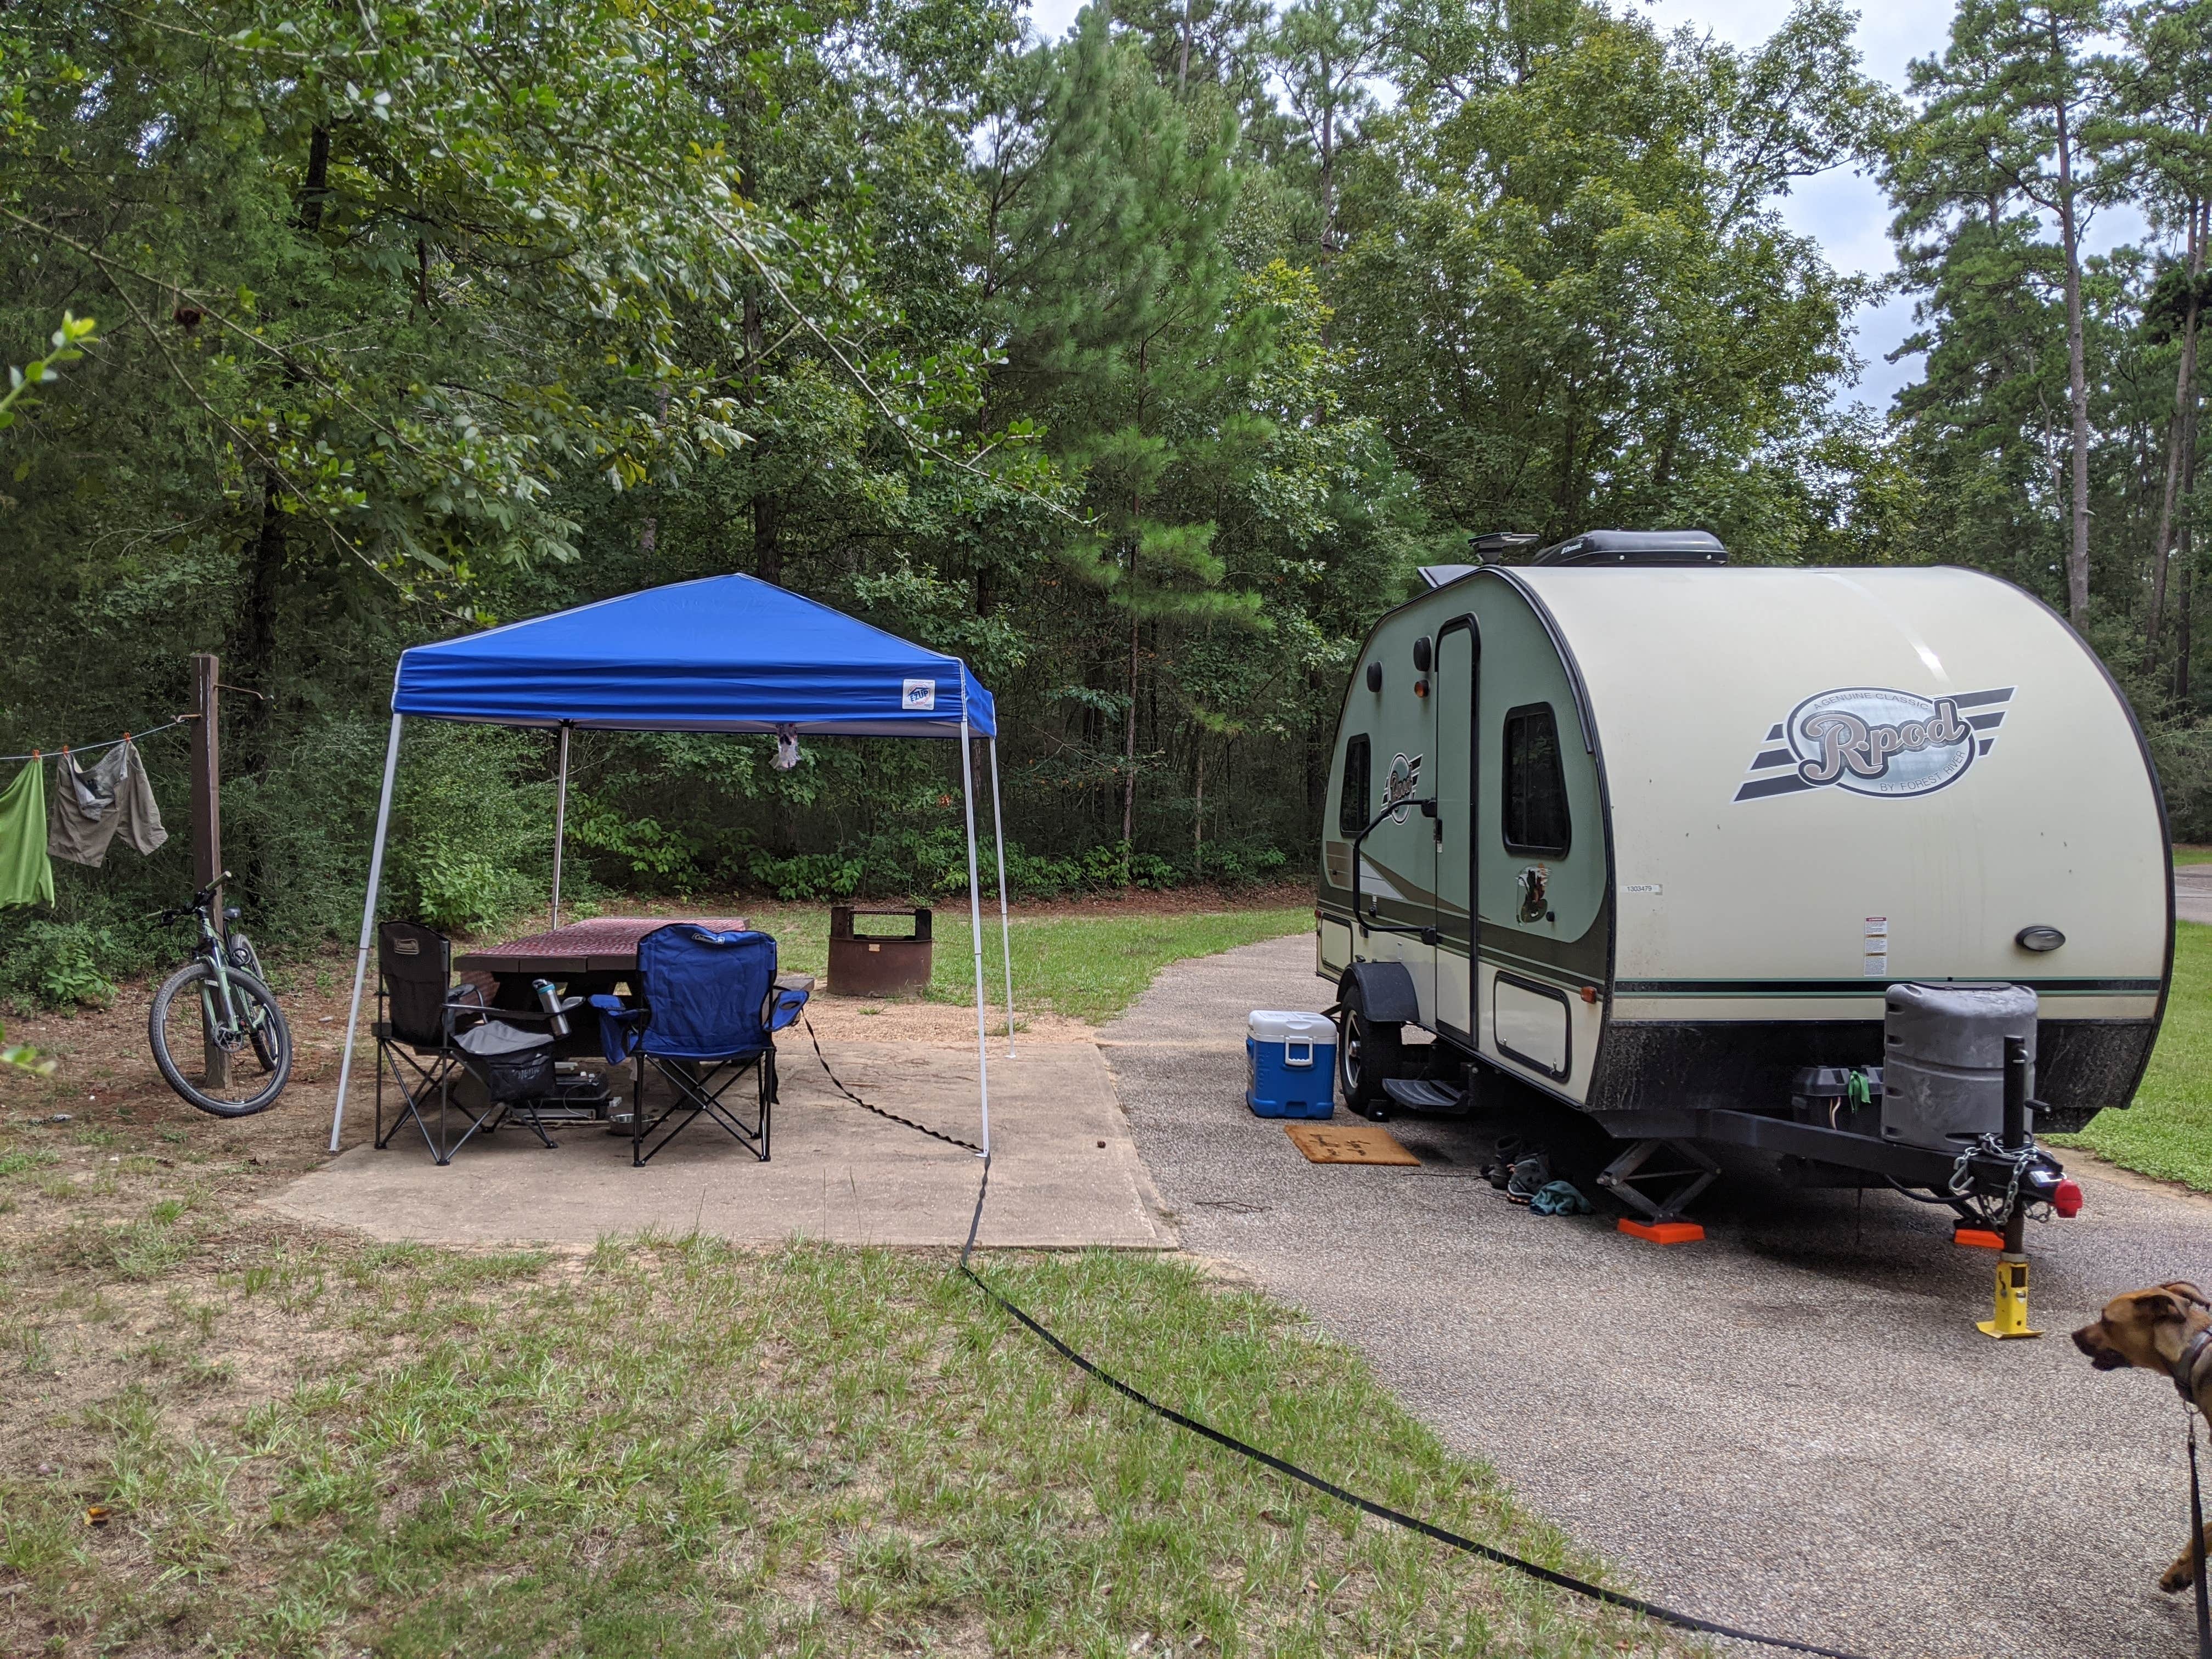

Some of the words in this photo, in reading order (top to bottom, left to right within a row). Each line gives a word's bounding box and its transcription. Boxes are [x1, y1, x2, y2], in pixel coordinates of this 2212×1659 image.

[1821, 693, 1872, 706] GENUINE
[1875, 693, 1929, 710] CLASSIC
[1880, 782, 1895, 792] BY
[1900, 772, 1942, 791] FOREST
[1943, 750, 1966, 775] RIVER
